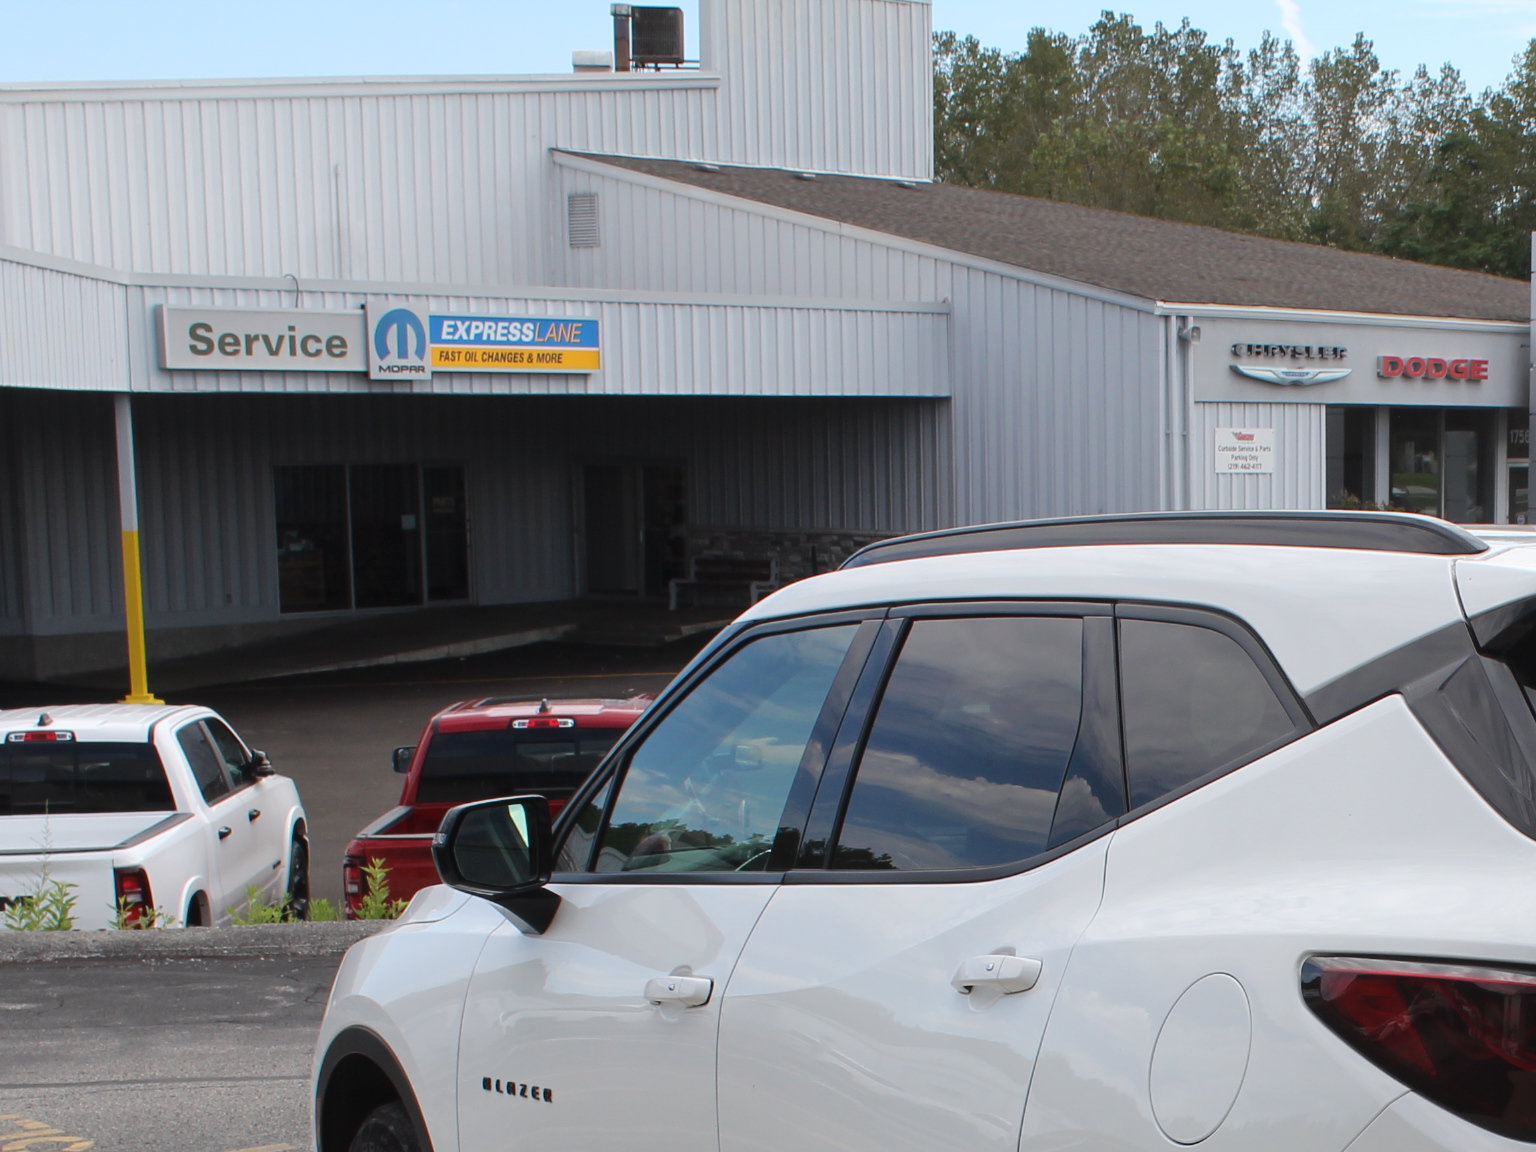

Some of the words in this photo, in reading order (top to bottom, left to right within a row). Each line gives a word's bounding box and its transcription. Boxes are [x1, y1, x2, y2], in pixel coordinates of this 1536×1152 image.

[188, 321, 349, 359] Service
[1230, 342, 1349, 360] CHRYSLER
[439, 350, 462, 362] FAST
[465, 351, 479, 363] OIL
[482, 351, 525, 364] CHANGES
[527, 353, 534, 364] &
[537, 352, 563, 364] MORE
[1377, 354, 1489, 382] DODGE
[378, 364, 426, 374] MOPAR
[482, 1076, 554, 1104] BLAZER
